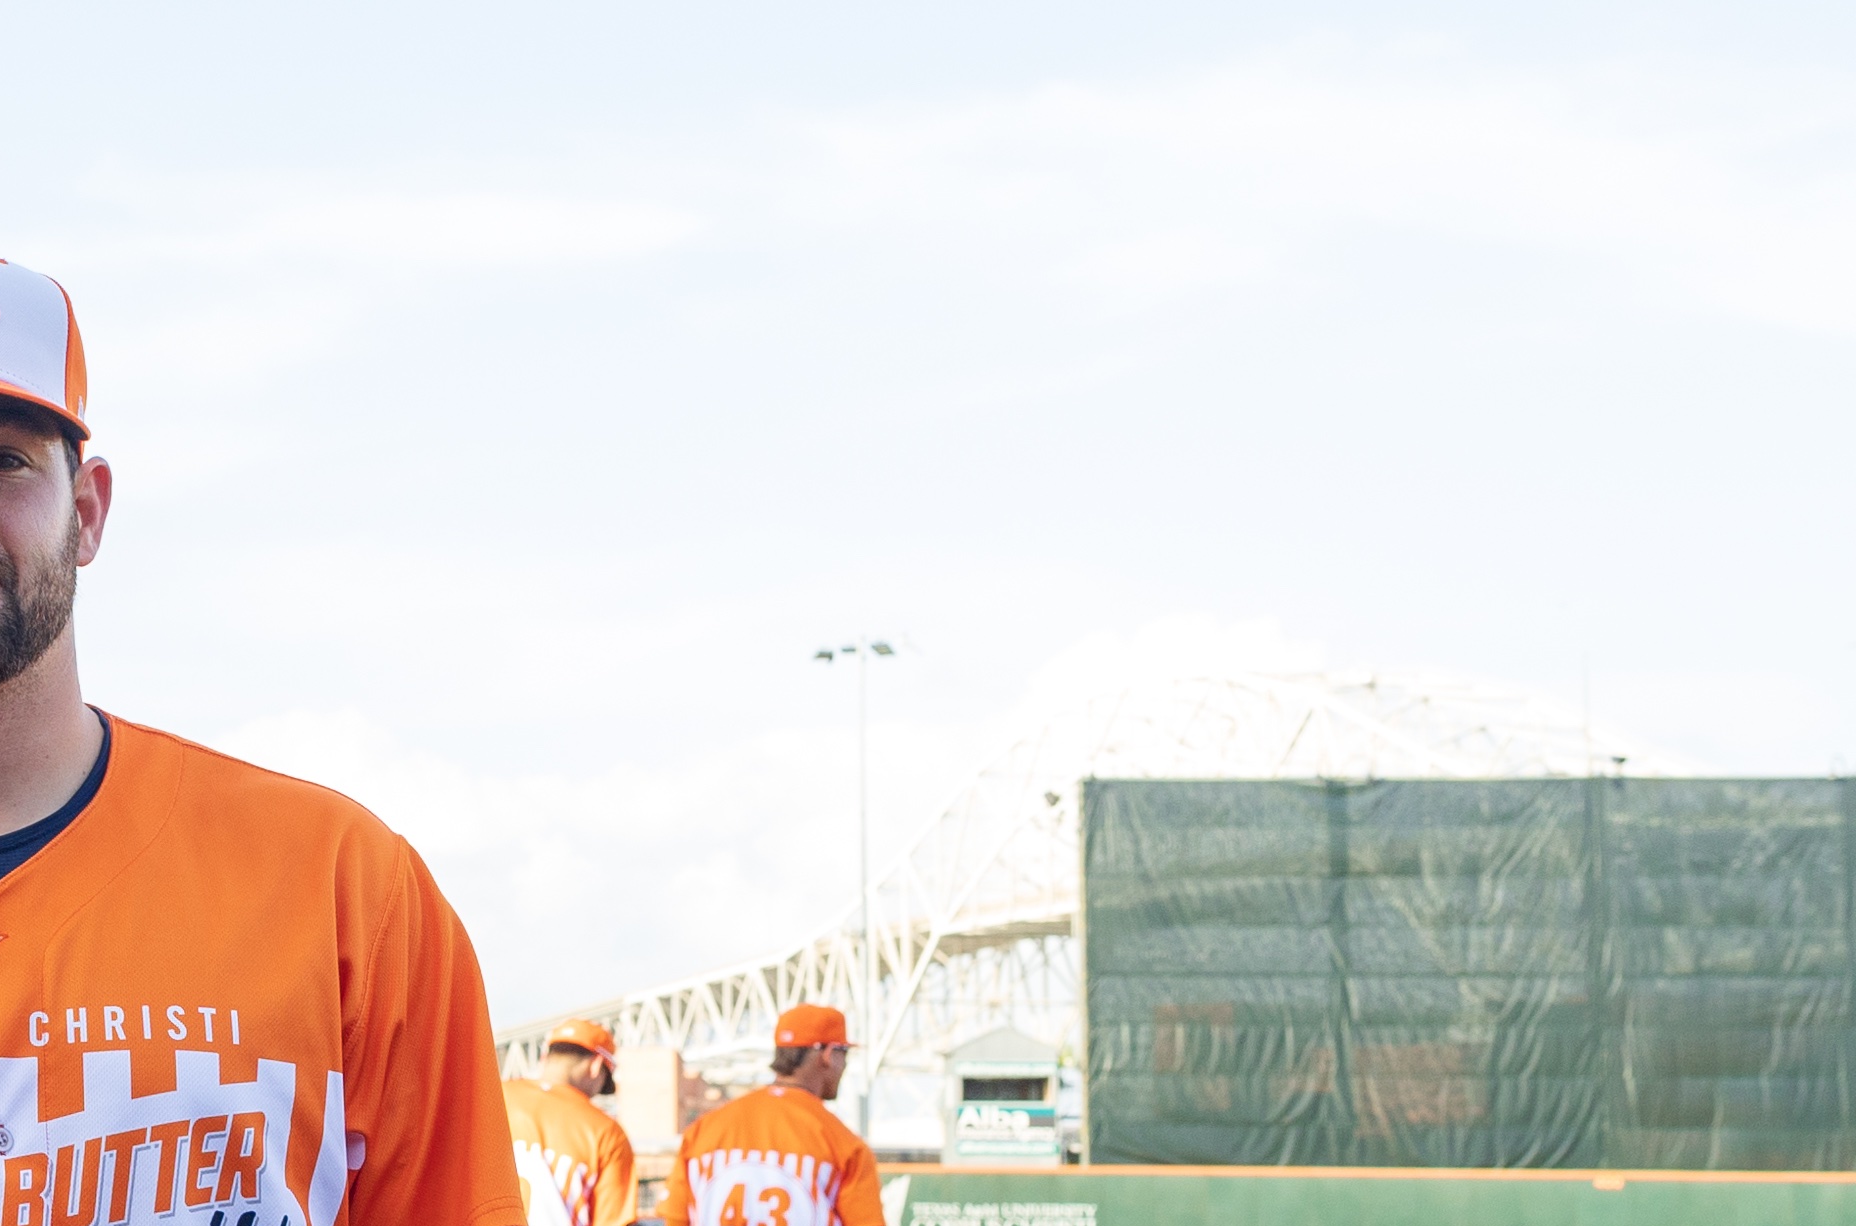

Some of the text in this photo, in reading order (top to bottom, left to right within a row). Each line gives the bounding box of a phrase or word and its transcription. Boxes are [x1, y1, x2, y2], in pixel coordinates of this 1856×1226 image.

[28, 1005, 240, 1047] CHRISTI
[958, 1104, 1031, 1129] Alba
[911, 1202, 961, 1217] TEXAS
[1001, 1202, 1098, 1218] UNIVERSITY
